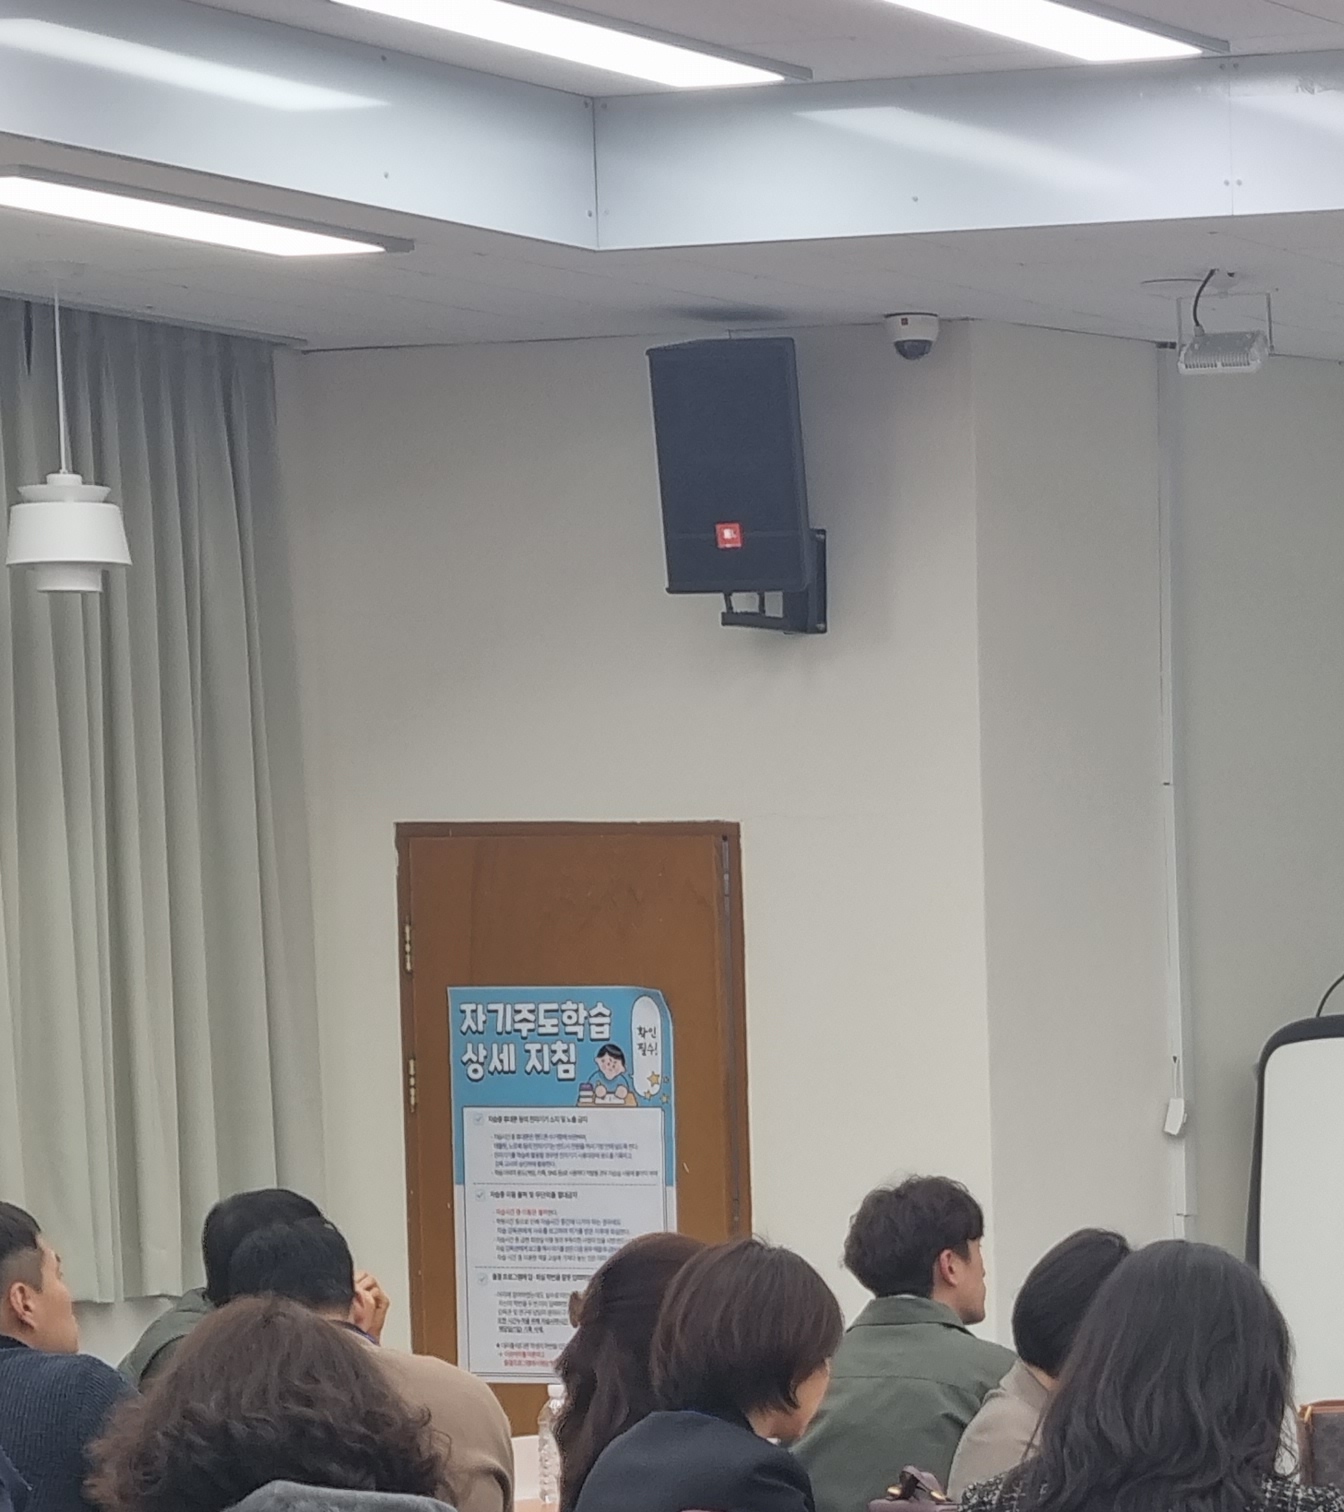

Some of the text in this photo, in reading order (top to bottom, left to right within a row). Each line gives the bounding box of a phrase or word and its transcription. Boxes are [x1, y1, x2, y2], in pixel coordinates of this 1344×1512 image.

[459, 1001, 612, 1041] 자기주도학습
[460, 1040, 577, 1081] 상세 지침
